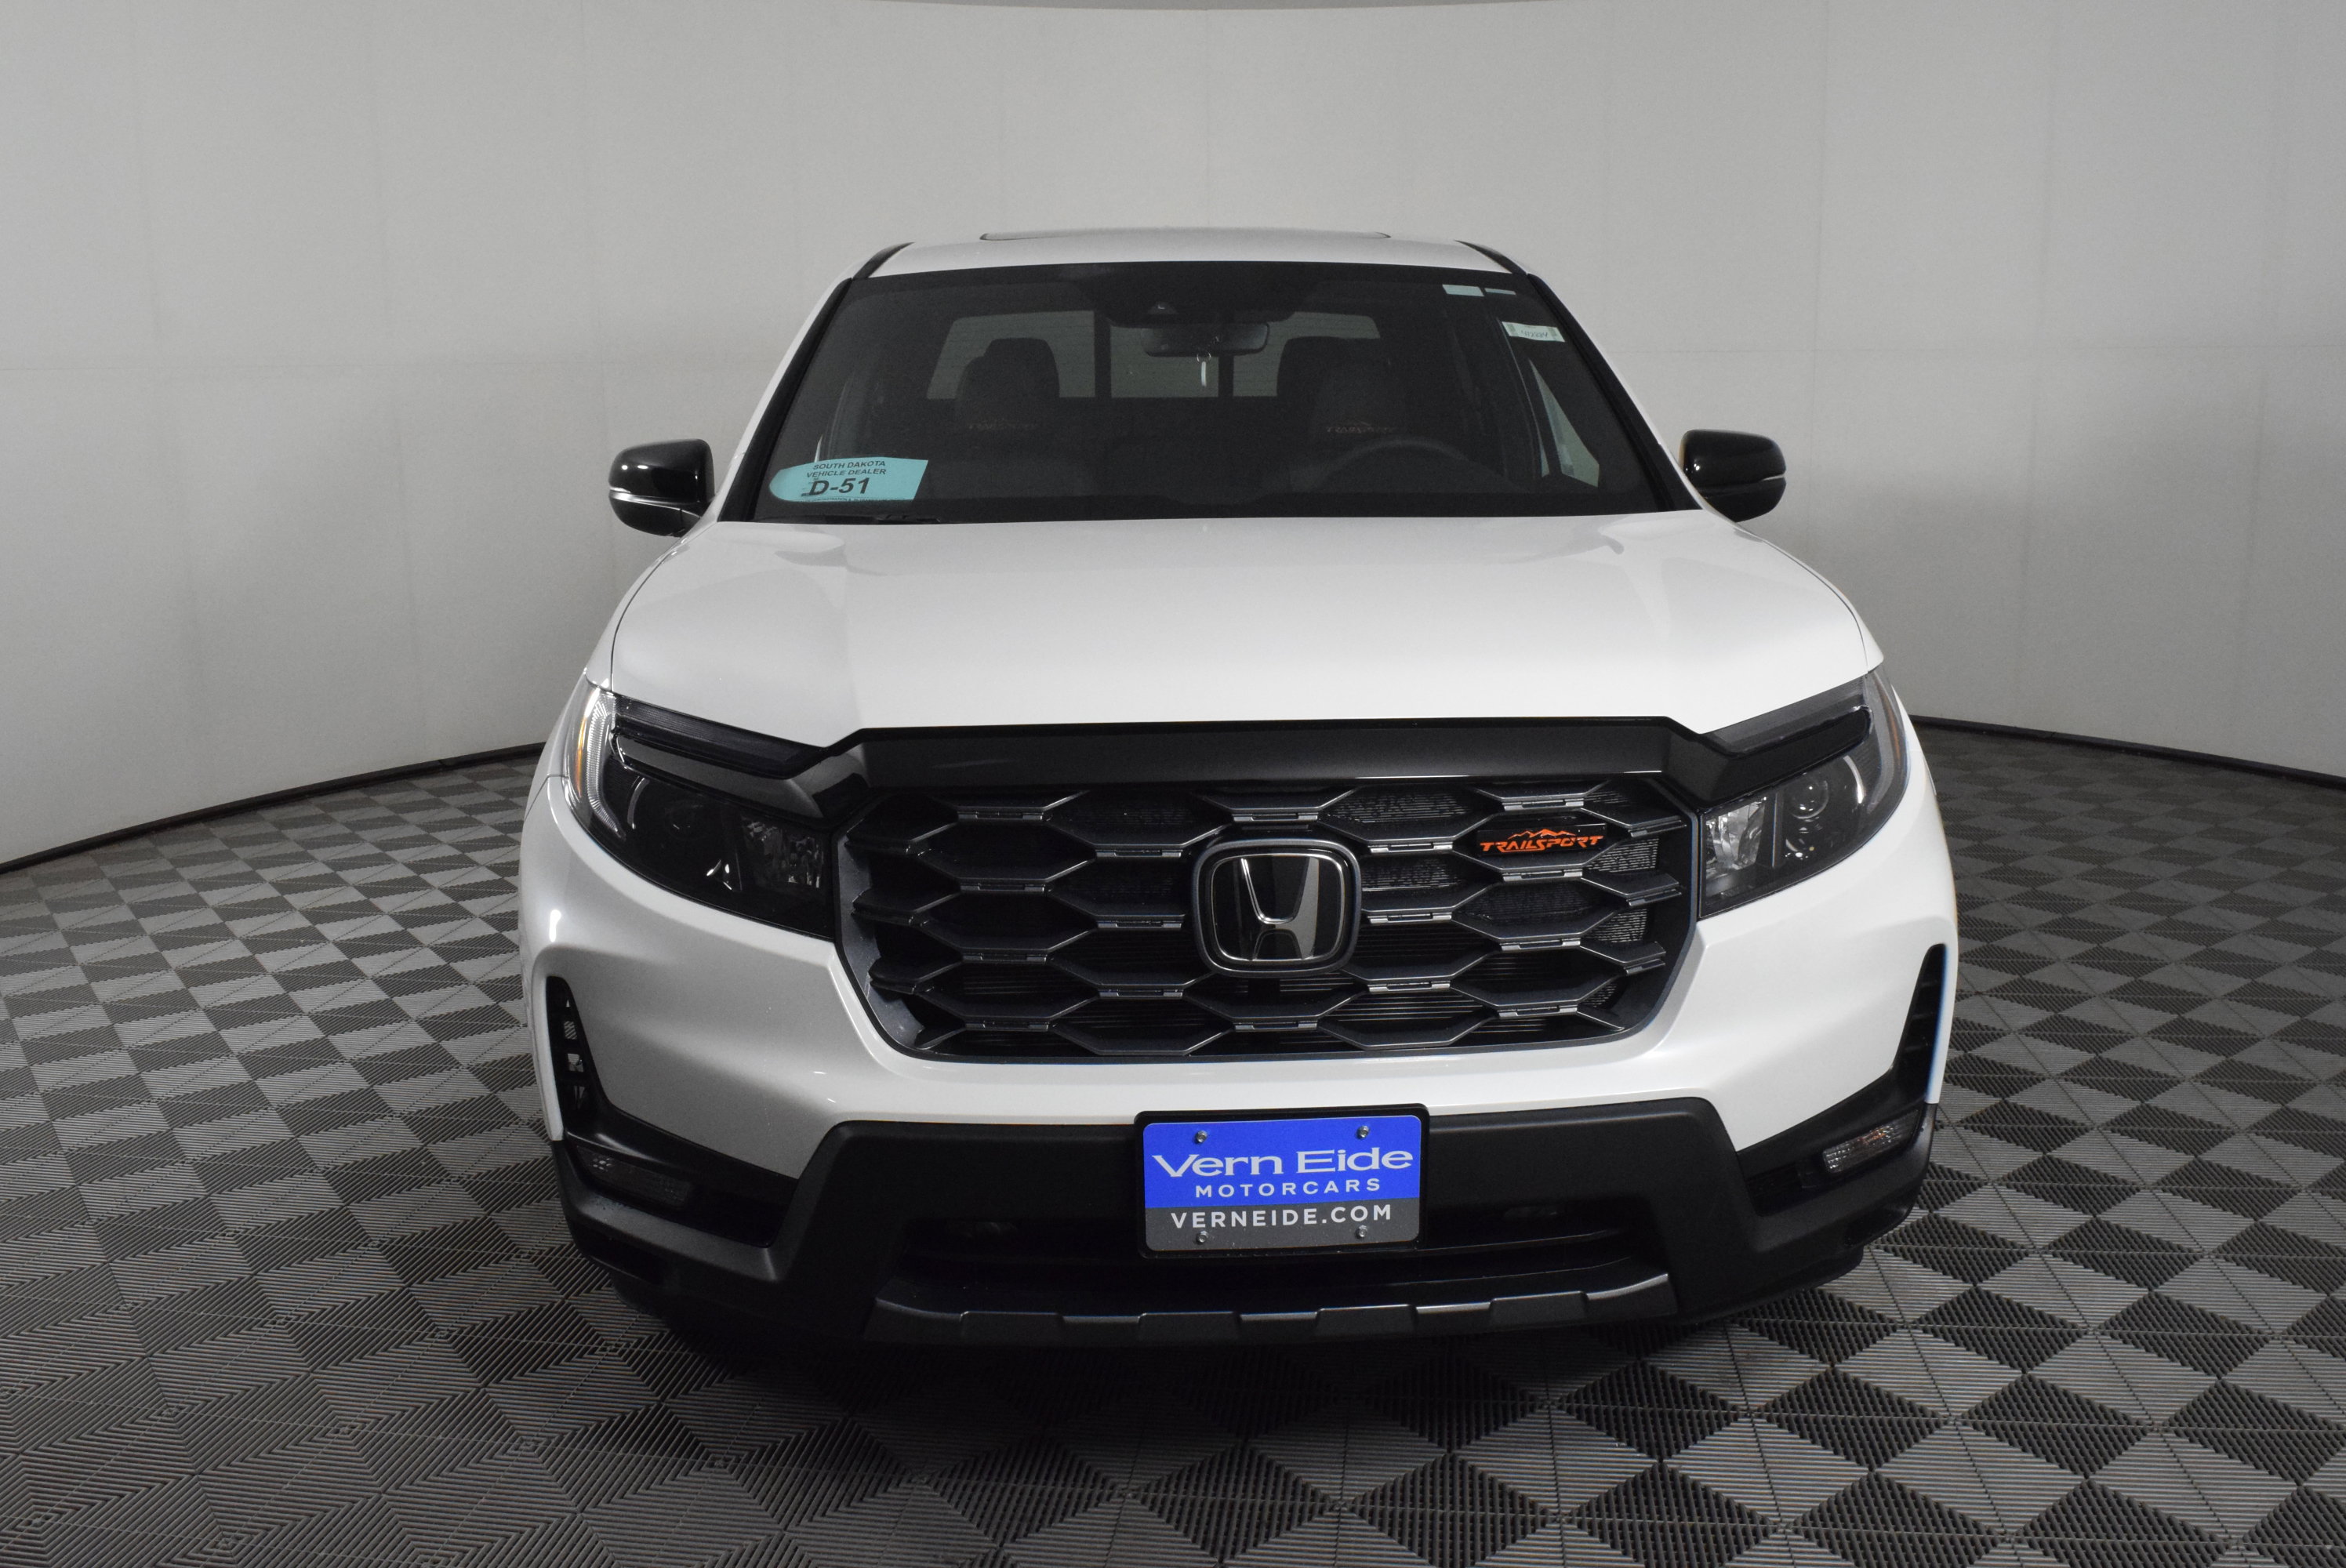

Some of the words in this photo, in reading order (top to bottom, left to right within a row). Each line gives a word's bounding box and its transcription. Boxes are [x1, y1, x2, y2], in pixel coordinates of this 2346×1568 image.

[806, 470, 845, 478] VEHICLE
[812, 462, 845, 470] SOUTH
[847, 460, 886, 469] DAKOTA
[808, 477, 870, 495] D-51
[1480, 835, 1604, 853] TRAILSPORT
[1151, 1153, 1284, 1178] Vern
[1295, 1146, 1414, 1174] Eide
[1195, 1178, 1381, 1199] MOTORCARS
[1171, 1203, 1393, 1229] VERNEIDE.COM
